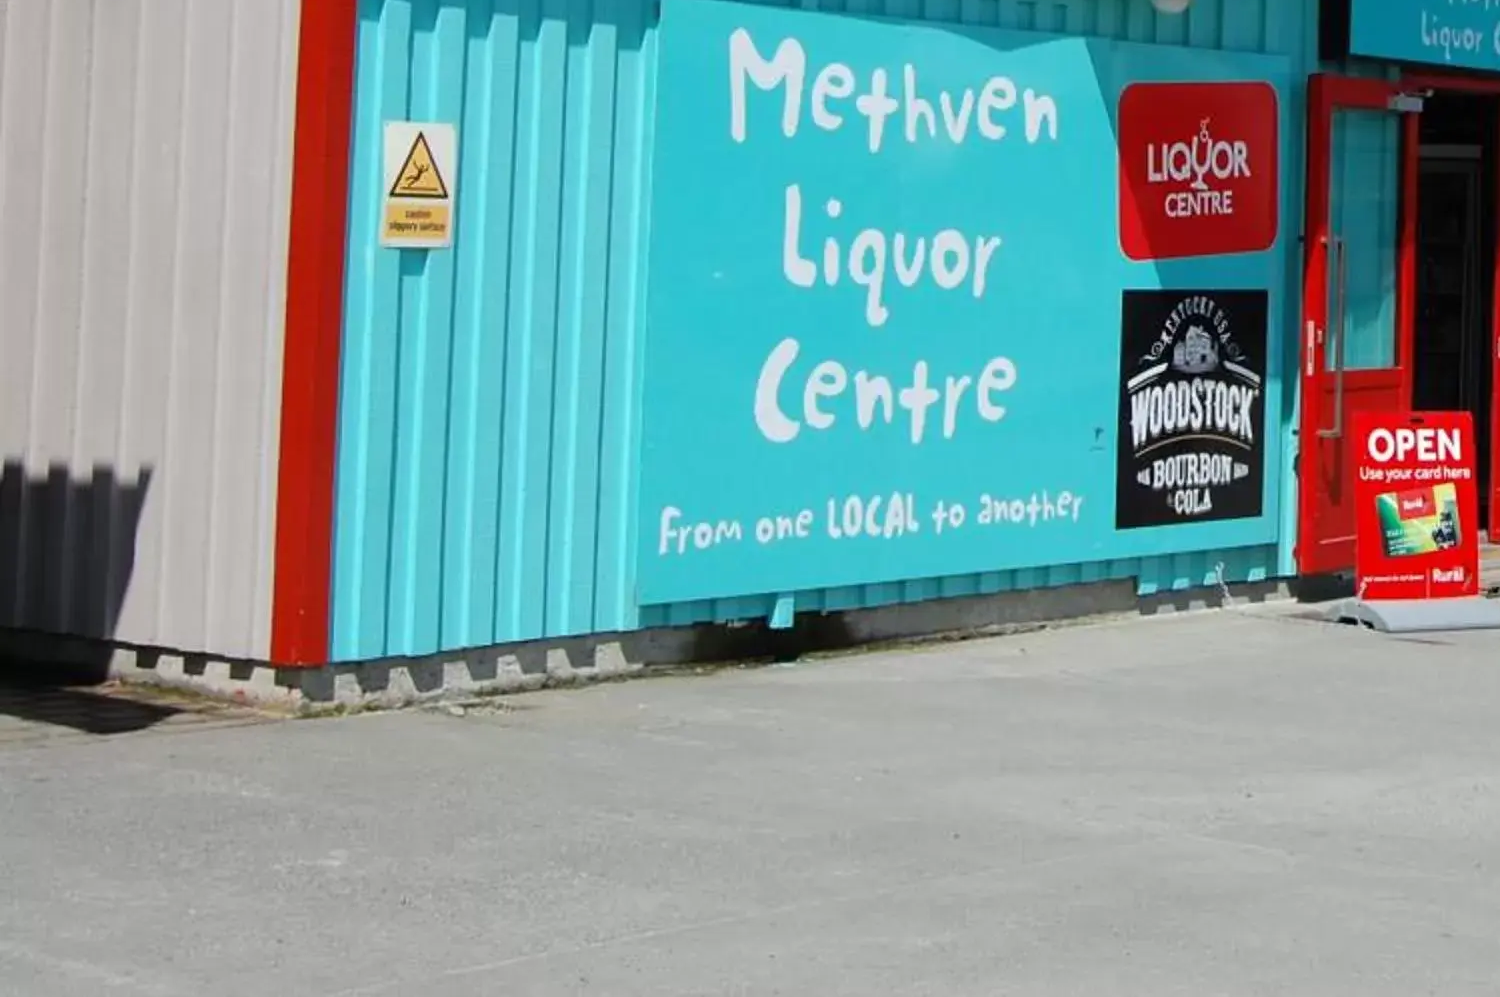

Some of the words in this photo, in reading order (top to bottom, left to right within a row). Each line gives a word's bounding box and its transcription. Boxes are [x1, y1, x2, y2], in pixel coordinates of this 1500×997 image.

[1421, 9, 1483, 60] Liquor
[729, 27, 1057, 153] Methven
[1147, 135, 1251, 190] LIQUOR
[1164, 190, 1233, 217] CENTRE
[783, 184, 1001, 327] Liquor
[1160, 296, 1215, 347] KENTUCKY
[1213, 309, 1232, 344] USA
[754, 338, 1017, 444] Centre
[1130, 377, 1254, 449] WOODSTOCK
[1368, 427, 1462, 463] OPEN
[1152, 452, 1233, 490] BOURBON
[1360, 466, 1384, 481] Use
[1385, 468, 1411, 483] your
[1414, 466, 1441, 480] card
[1444, 465, 1471, 480] here
[658, 505, 742, 556] From
[755, 508, 813, 544] one
[827, 491, 920, 540] LOCAL
[932, 499, 966, 534] to
[977, 489, 1082, 528] another
[1174, 488, 1213, 516] COLA
